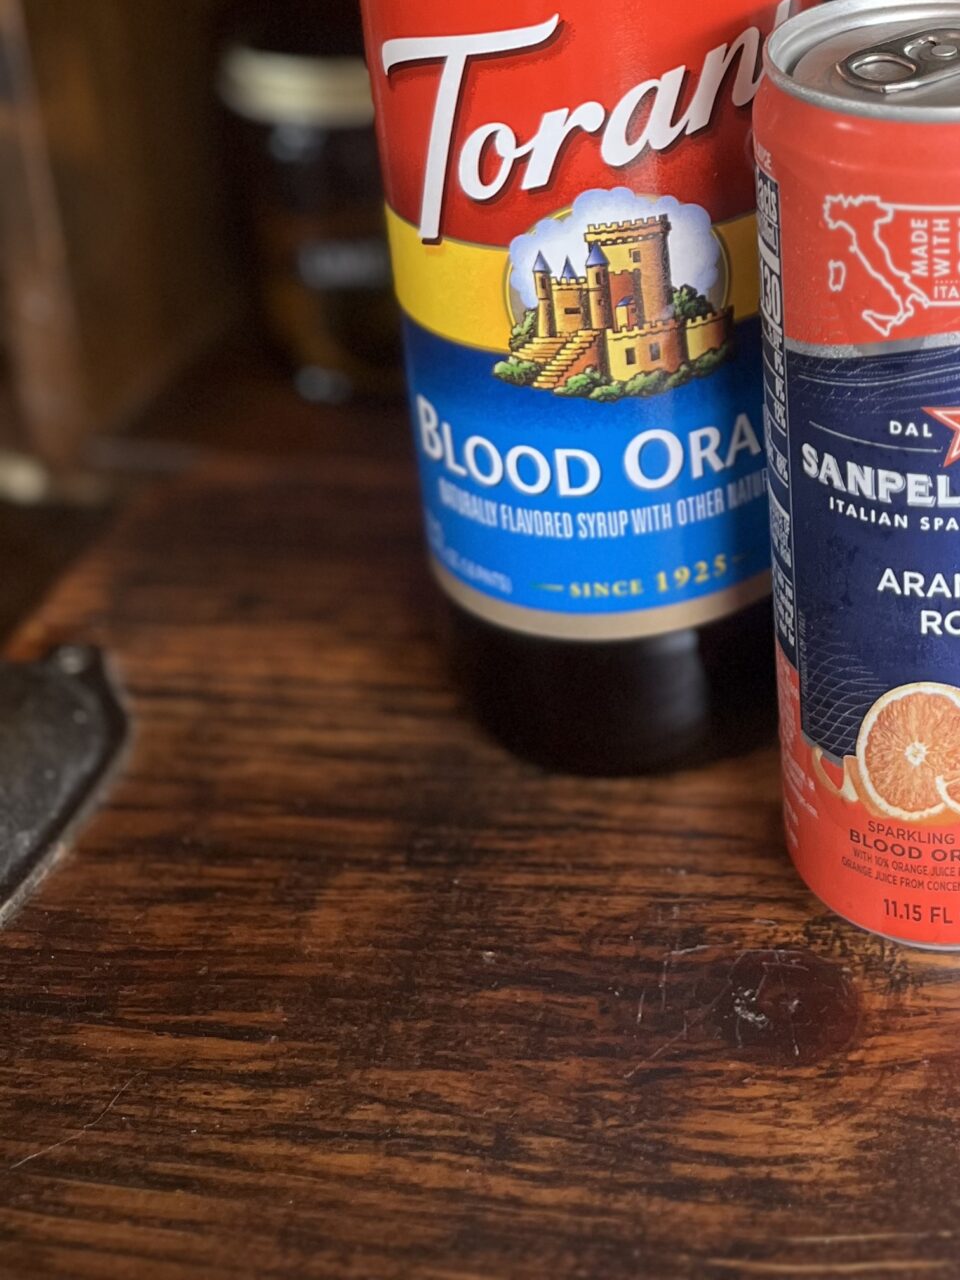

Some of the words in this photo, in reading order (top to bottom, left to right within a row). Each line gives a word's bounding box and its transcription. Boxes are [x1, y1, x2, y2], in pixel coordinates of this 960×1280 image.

[911, 218, 928, 277] MADE
[933, 218, 950, 278] WITH
[889, 420, 933, 438] DAL
[417, 394, 601, 497] BLOOD
[500, 503, 573, 539] FLAVORED
[577, 509, 629, 539] SYRUP
[631, 502, 673, 535] WITH
[677, 487, 725, 526] OTHER
[829, 496, 909, 529] ITALIAN
[569, 579, 643, 598] SINCE
[656, 553, 728, 593] 1925
[849, 828, 923, 859] BLOOD
[868, 820, 955, 845] SPARKLING
[852, 847, 873, 862] WITH
[891, 860, 928, 876] ORANGE
[930, 866, 955, 877] JUICE
[874, 871, 898, 886] JUICE
[900, 876, 925, 890] FROM
[883, 898, 922, 922] 11.15
[930, 906, 954, 924] FL
